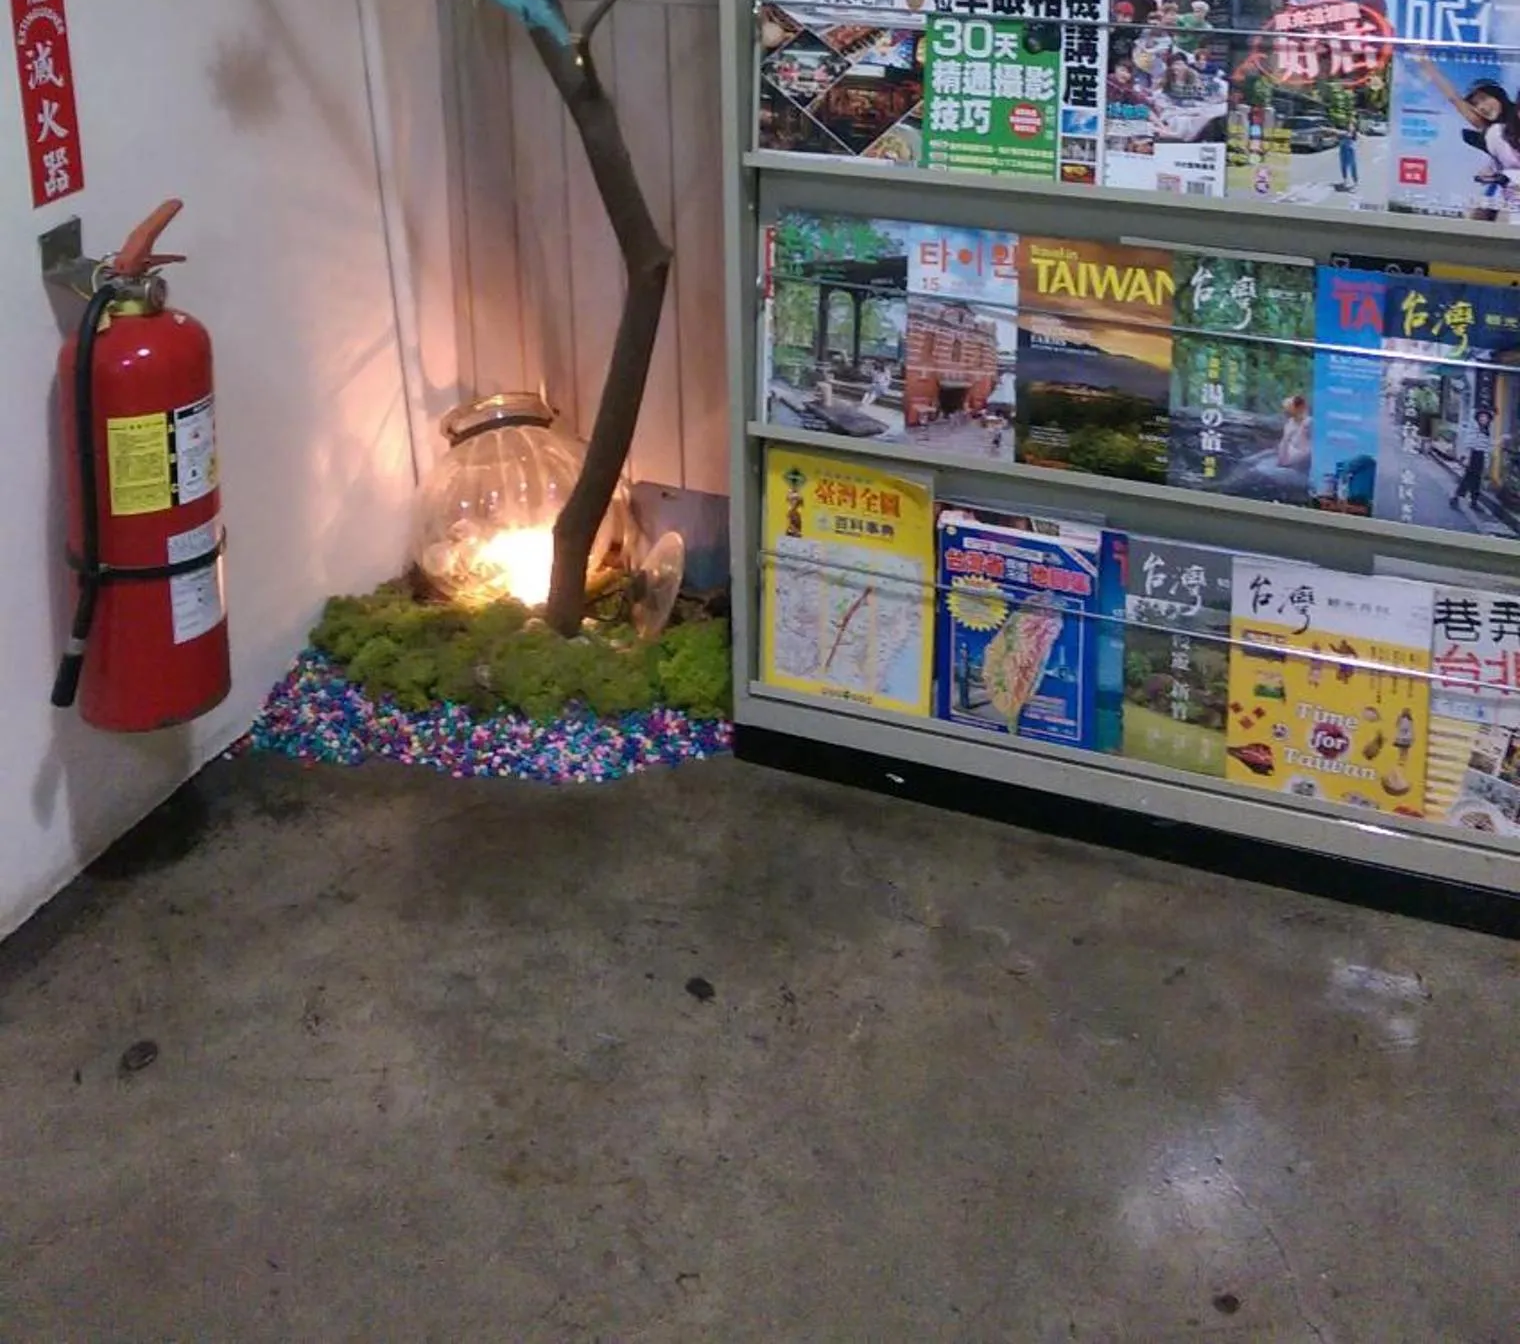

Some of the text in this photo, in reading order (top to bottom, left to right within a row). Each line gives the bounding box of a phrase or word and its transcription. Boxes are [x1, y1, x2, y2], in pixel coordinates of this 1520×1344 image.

[24, 41, 70, 198] 滅火器
[930, 96, 991, 134] 技巧
[1030, 257, 1175, 306] TAIWAN
[1296, 702, 1360, 731] Time
[1310, 729, 1349, 751] for
